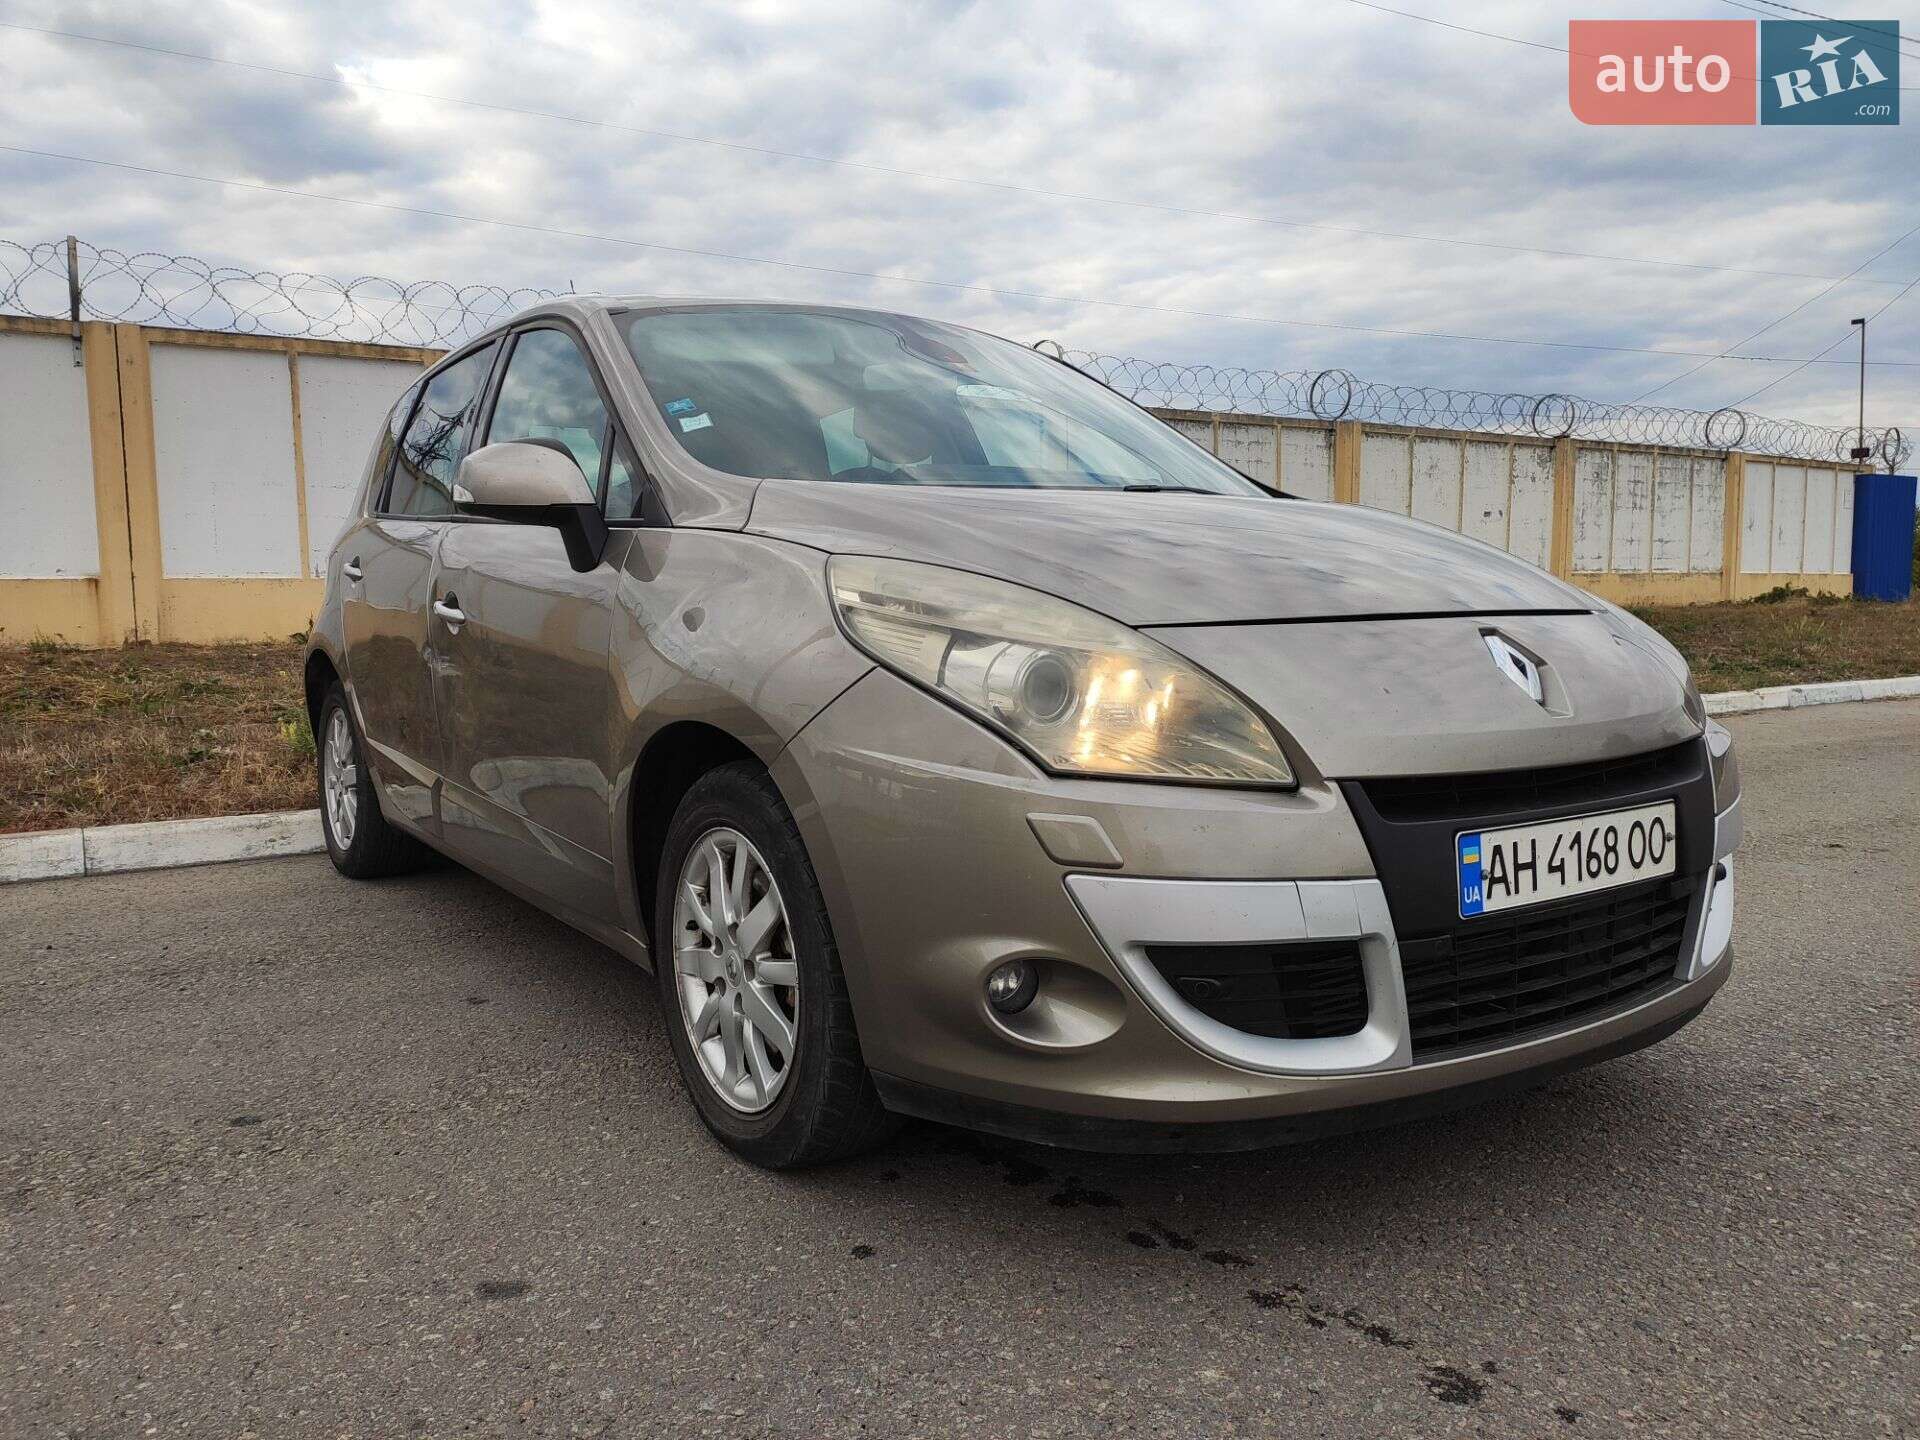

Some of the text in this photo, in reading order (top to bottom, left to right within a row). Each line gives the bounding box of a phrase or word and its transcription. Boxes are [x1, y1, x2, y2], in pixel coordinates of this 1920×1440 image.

[1486, 838, 1537, 899] AH
[1547, 825, 1619, 885] 4168
[1464, 886, 1481, 903] UA
